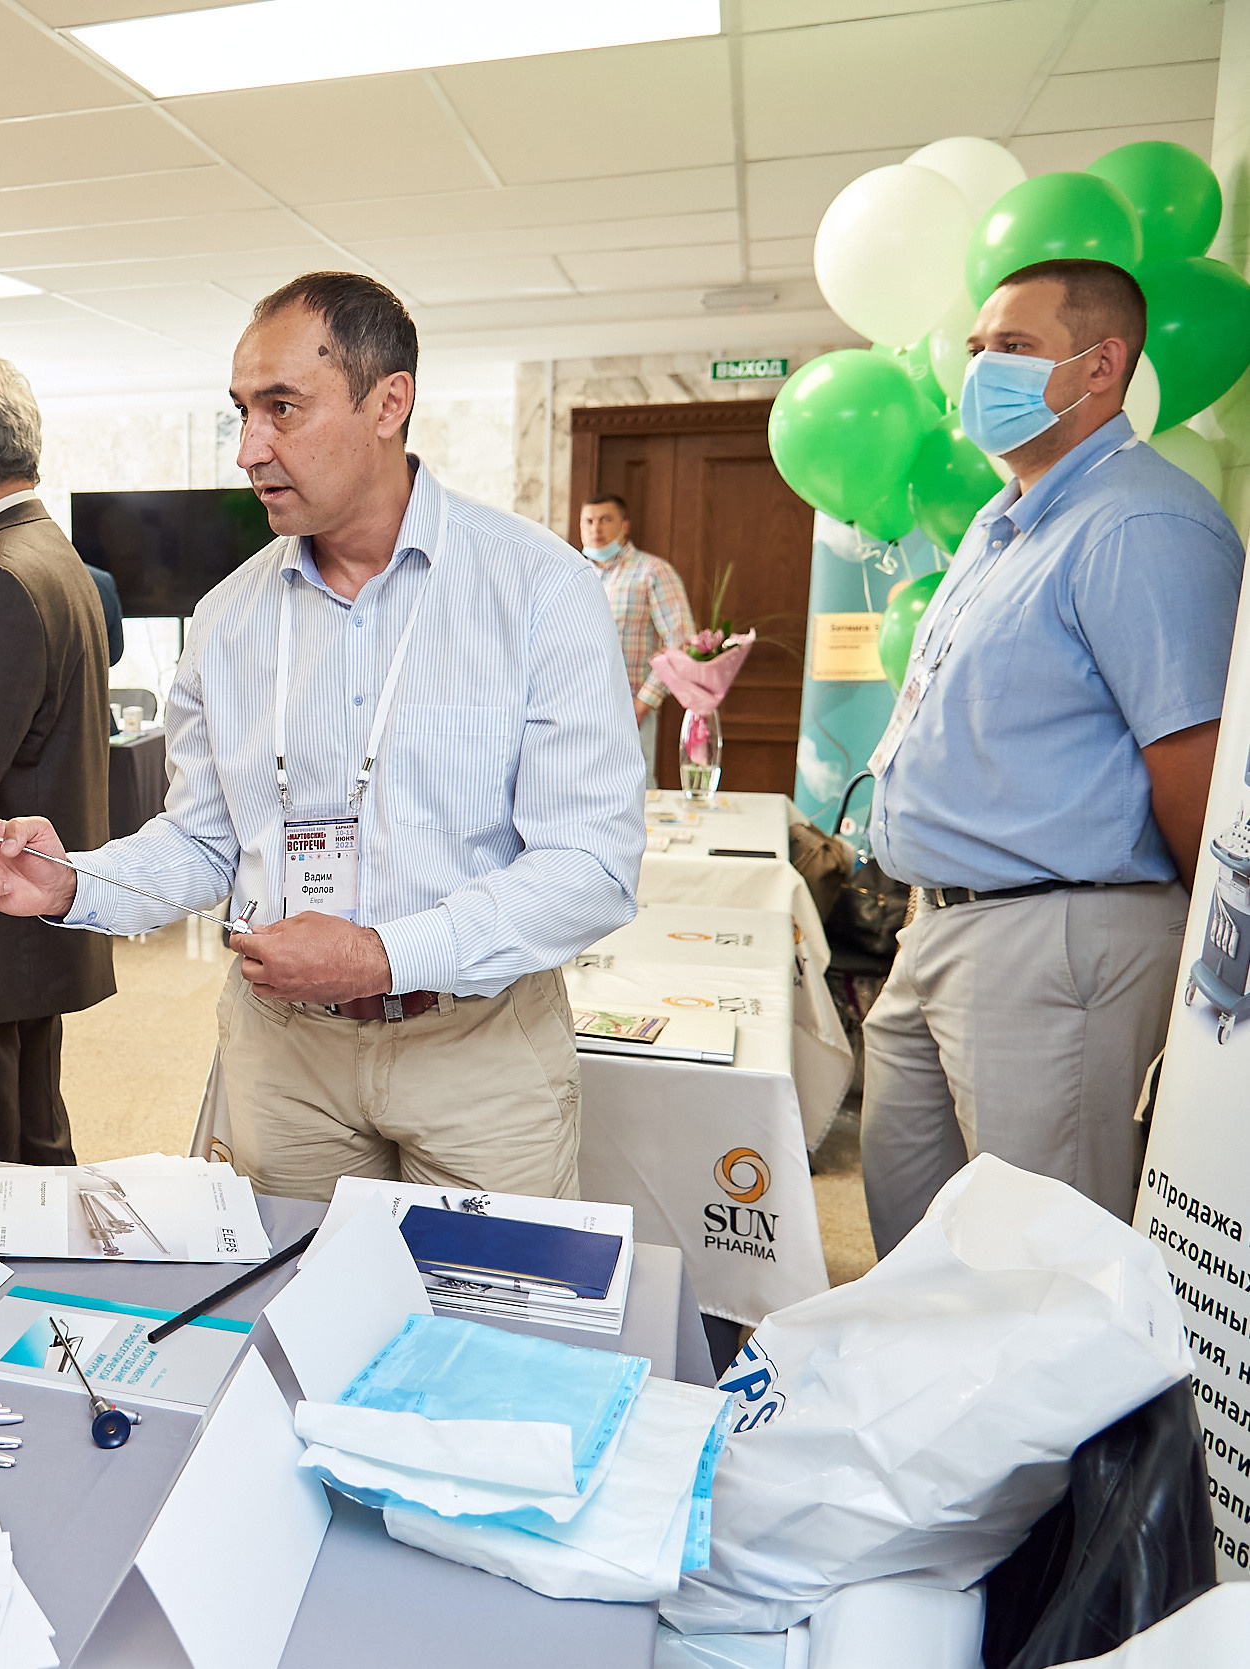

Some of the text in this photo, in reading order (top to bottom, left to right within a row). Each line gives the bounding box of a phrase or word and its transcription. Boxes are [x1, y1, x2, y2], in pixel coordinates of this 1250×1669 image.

[716, 360, 782, 378] ВЫХОД
[287, 840, 326, 851] ВСТРЕЧИ
[304, 872, 333, 883] Вадим
[301, 885, 334, 896] Фролов
[1157, 1172, 1243, 1242] Продажа
[703, 1203, 779, 1243] SUN
[222, 1228, 238, 1253] ELEPS
[704, 1235, 777, 1263] PHARMA
